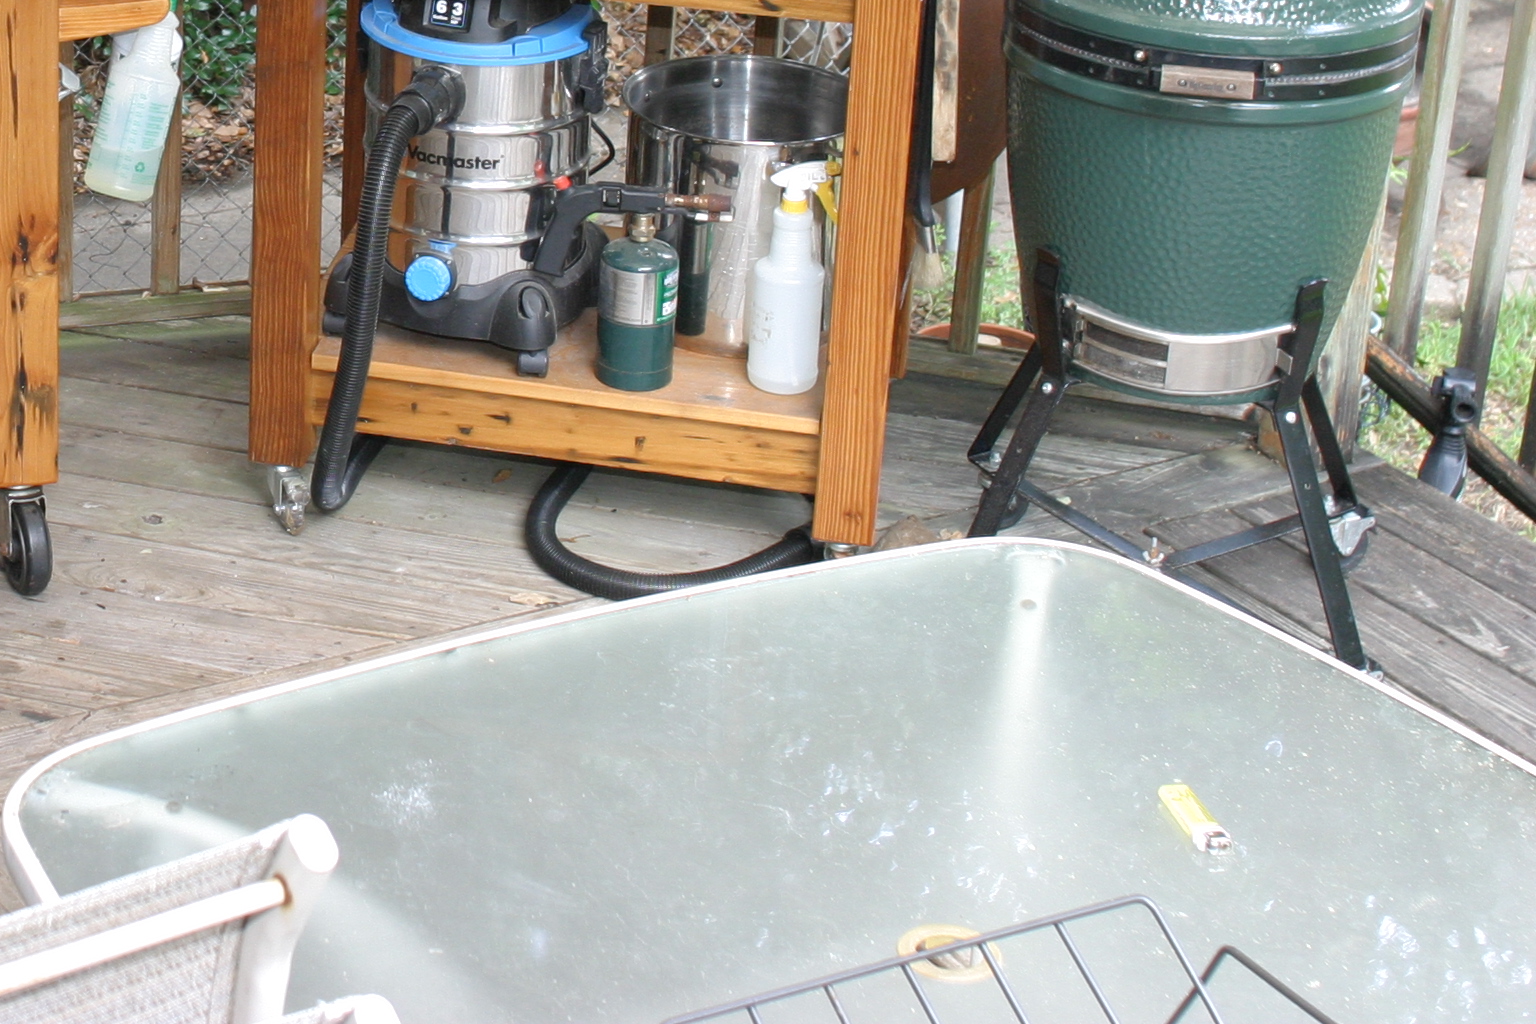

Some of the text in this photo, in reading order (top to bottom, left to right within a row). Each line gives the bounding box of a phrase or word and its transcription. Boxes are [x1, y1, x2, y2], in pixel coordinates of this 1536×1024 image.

[436, 0, 464, 16] 6 3
[407, 142, 501, 170] Vacmaster
